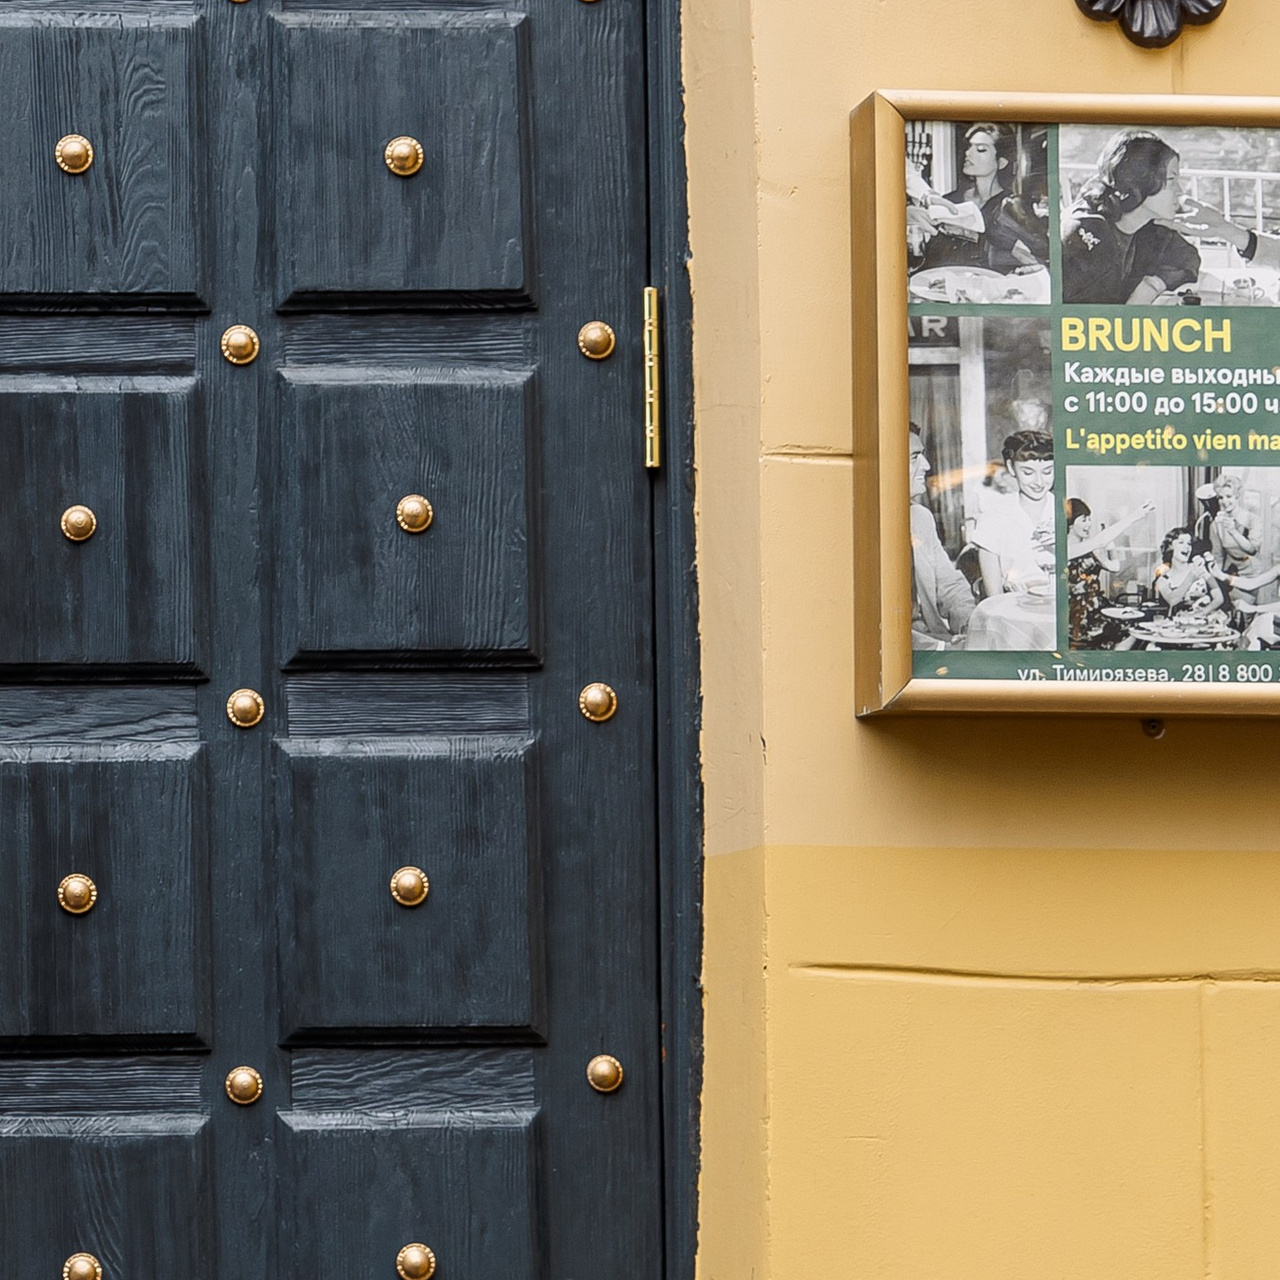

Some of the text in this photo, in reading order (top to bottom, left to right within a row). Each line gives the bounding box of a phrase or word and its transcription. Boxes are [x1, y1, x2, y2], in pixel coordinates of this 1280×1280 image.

[1061, 316, 1232, 353] BRUNCH
[1064, 361, 1165, 387] Каждые
[1064, 394, 1079, 413] с
[1085, 391, 1148, 414] 11:00
[1154, 396, 1185, 416] до
[1191, 391, 1258, 414] 15:00
[1066, 428, 1187, 455] L'appetito
[1192, 428, 1241, 451] vien
[1052, 664, 1176, 682] Тимирязева,
[1236, 664, 1273, 682] 800
